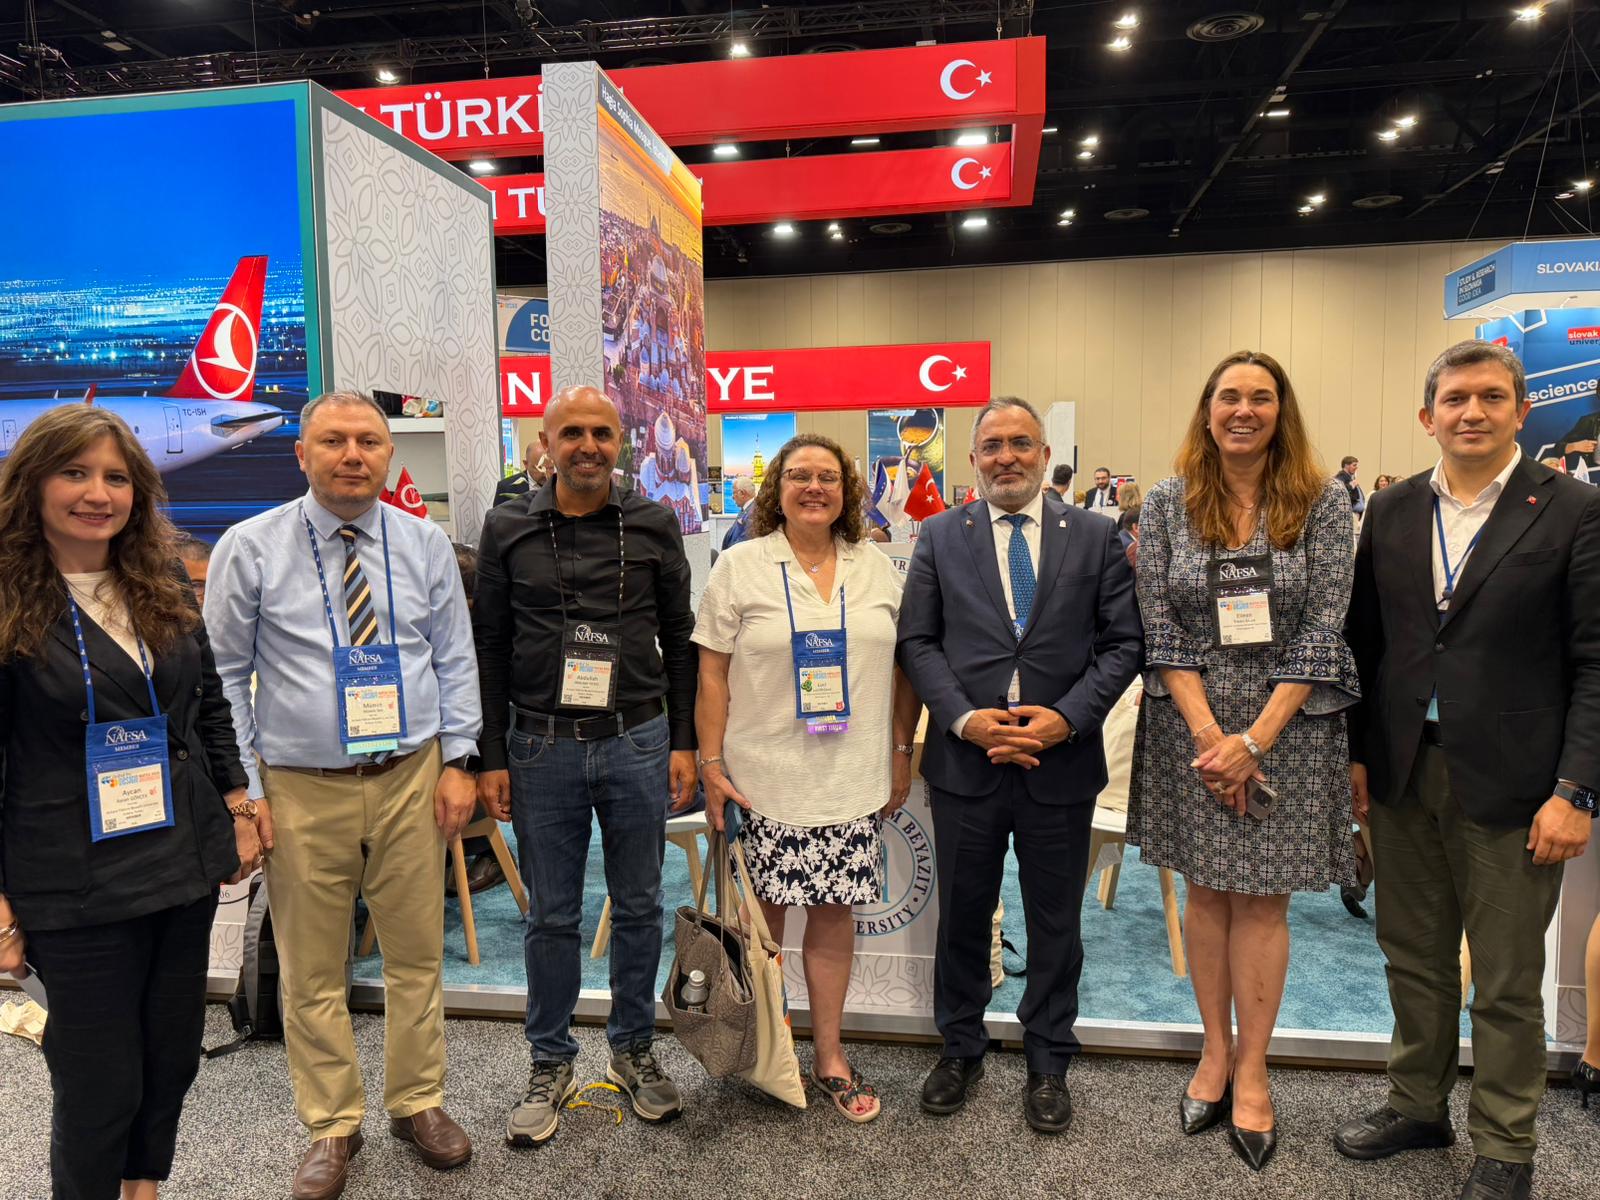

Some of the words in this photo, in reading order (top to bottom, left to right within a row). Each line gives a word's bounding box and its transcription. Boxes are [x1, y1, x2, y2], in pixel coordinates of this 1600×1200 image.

[602, 84, 617, 112] Hagia
[617, 102, 634, 131] Sophia
[1537, 261, 1600, 274] SLOVAKI
[1568, 330, 1598, 339] slovak
[499, 371, 541, 406] N
[1529, 378, 1598, 401] science
[1220, 567, 1257, 580] NAFSA
[575, 631, 609, 643] NAFSA
[806, 638, 833, 648] NAFSA
[349, 654, 383, 665] NAFSA
[105, 729, 148, 745] NAFSA
[114, 744, 140, 752] MEMBER
[122, 788, 142, 797] Aycan
[902, 821, 932, 896] BEYAZIT
